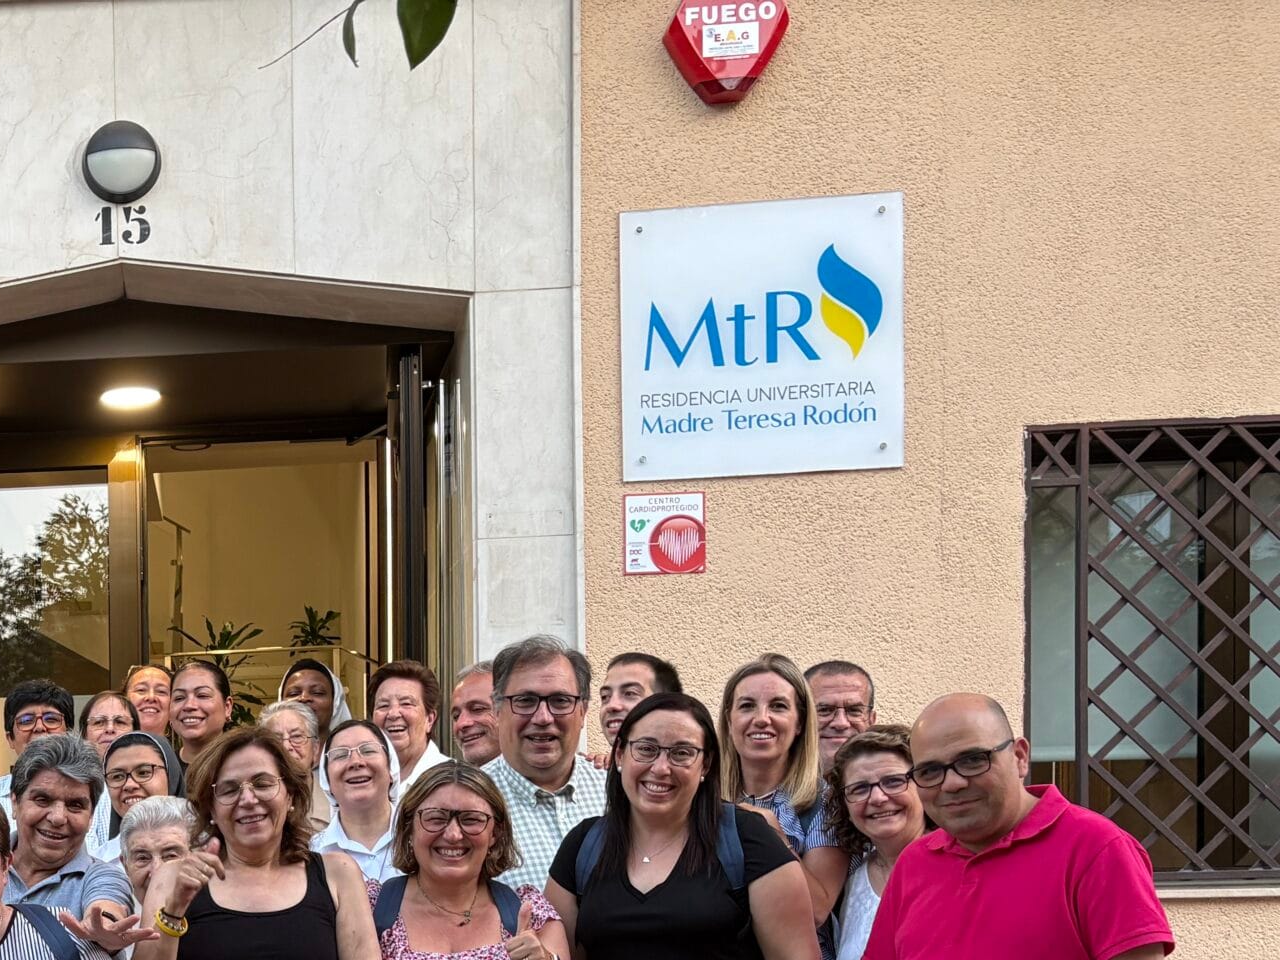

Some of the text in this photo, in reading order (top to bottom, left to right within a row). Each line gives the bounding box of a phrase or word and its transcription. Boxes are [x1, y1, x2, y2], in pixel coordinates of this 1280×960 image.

[685, 1, 777, 26] FUEGO
[94, 205, 152, 246] 15
[644, 290, 822, 372] MtR
[640, 380, 876, 409] RESIDENCIA UNIVERSITARIA
[641, 401, 877, 436] Madre Teresa Rodón
[628, 504, 699, 513] CARDIOPROTEGIDO
[648, 497, 681, 505] CENTRO
